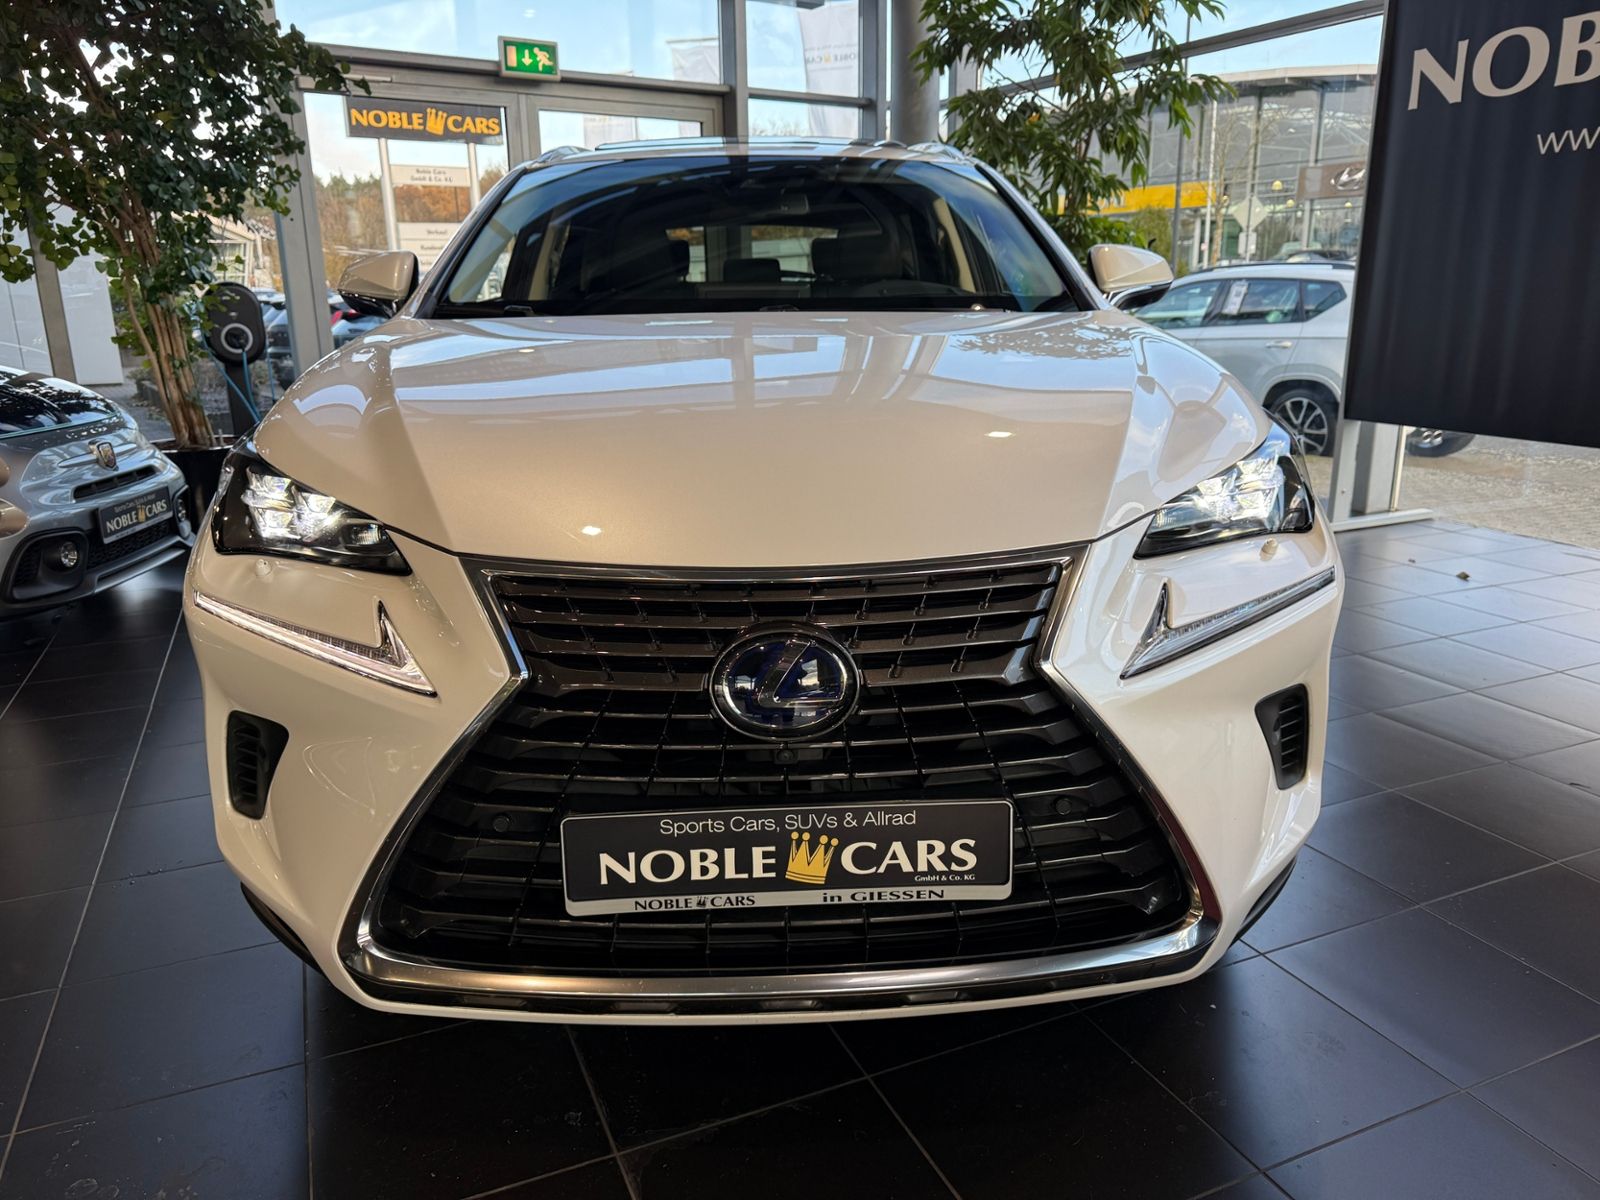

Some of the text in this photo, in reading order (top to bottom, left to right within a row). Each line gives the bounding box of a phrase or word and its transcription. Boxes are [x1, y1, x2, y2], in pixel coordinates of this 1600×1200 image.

[1408, 10, 1600, 110] NOB
[351, 109, 500, 134] NOBLE CARS
[106, 511, 137, 533] NOBLE
[145, 499, 167, 517] CARS
[659, 810, 916, 837] Sports Cars, SUVs & Allrad
[599, 838, 977, 885] NOBLE CARS
[635, 889, 945, 911] NOBLE CARS in GIESSEN
